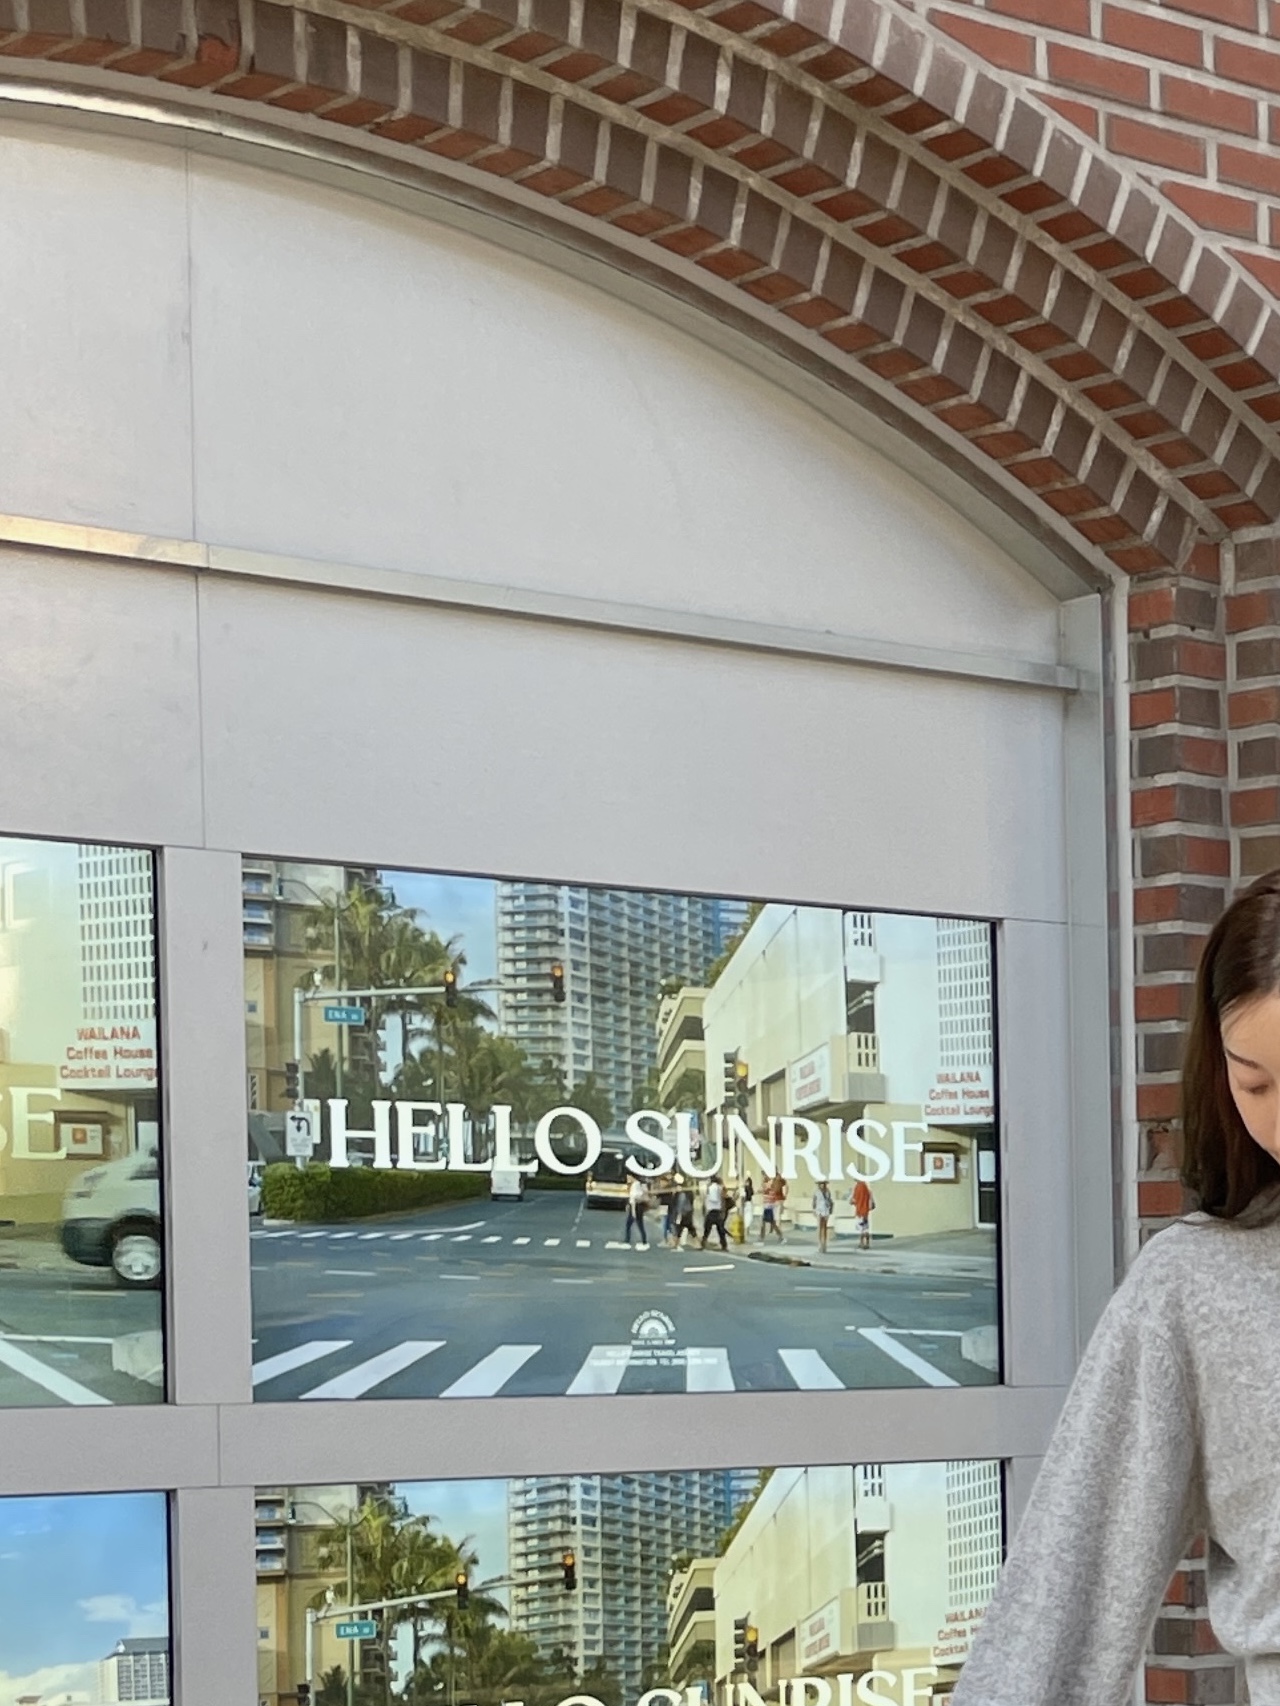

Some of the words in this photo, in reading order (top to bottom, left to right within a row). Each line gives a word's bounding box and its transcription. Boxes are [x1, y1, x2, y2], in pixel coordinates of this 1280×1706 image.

[963, 1103, 994, 1118] Loung
[327, 1098, 602, 1175] HELLO
[624, 1109, 933, 1183] SUNRISE
